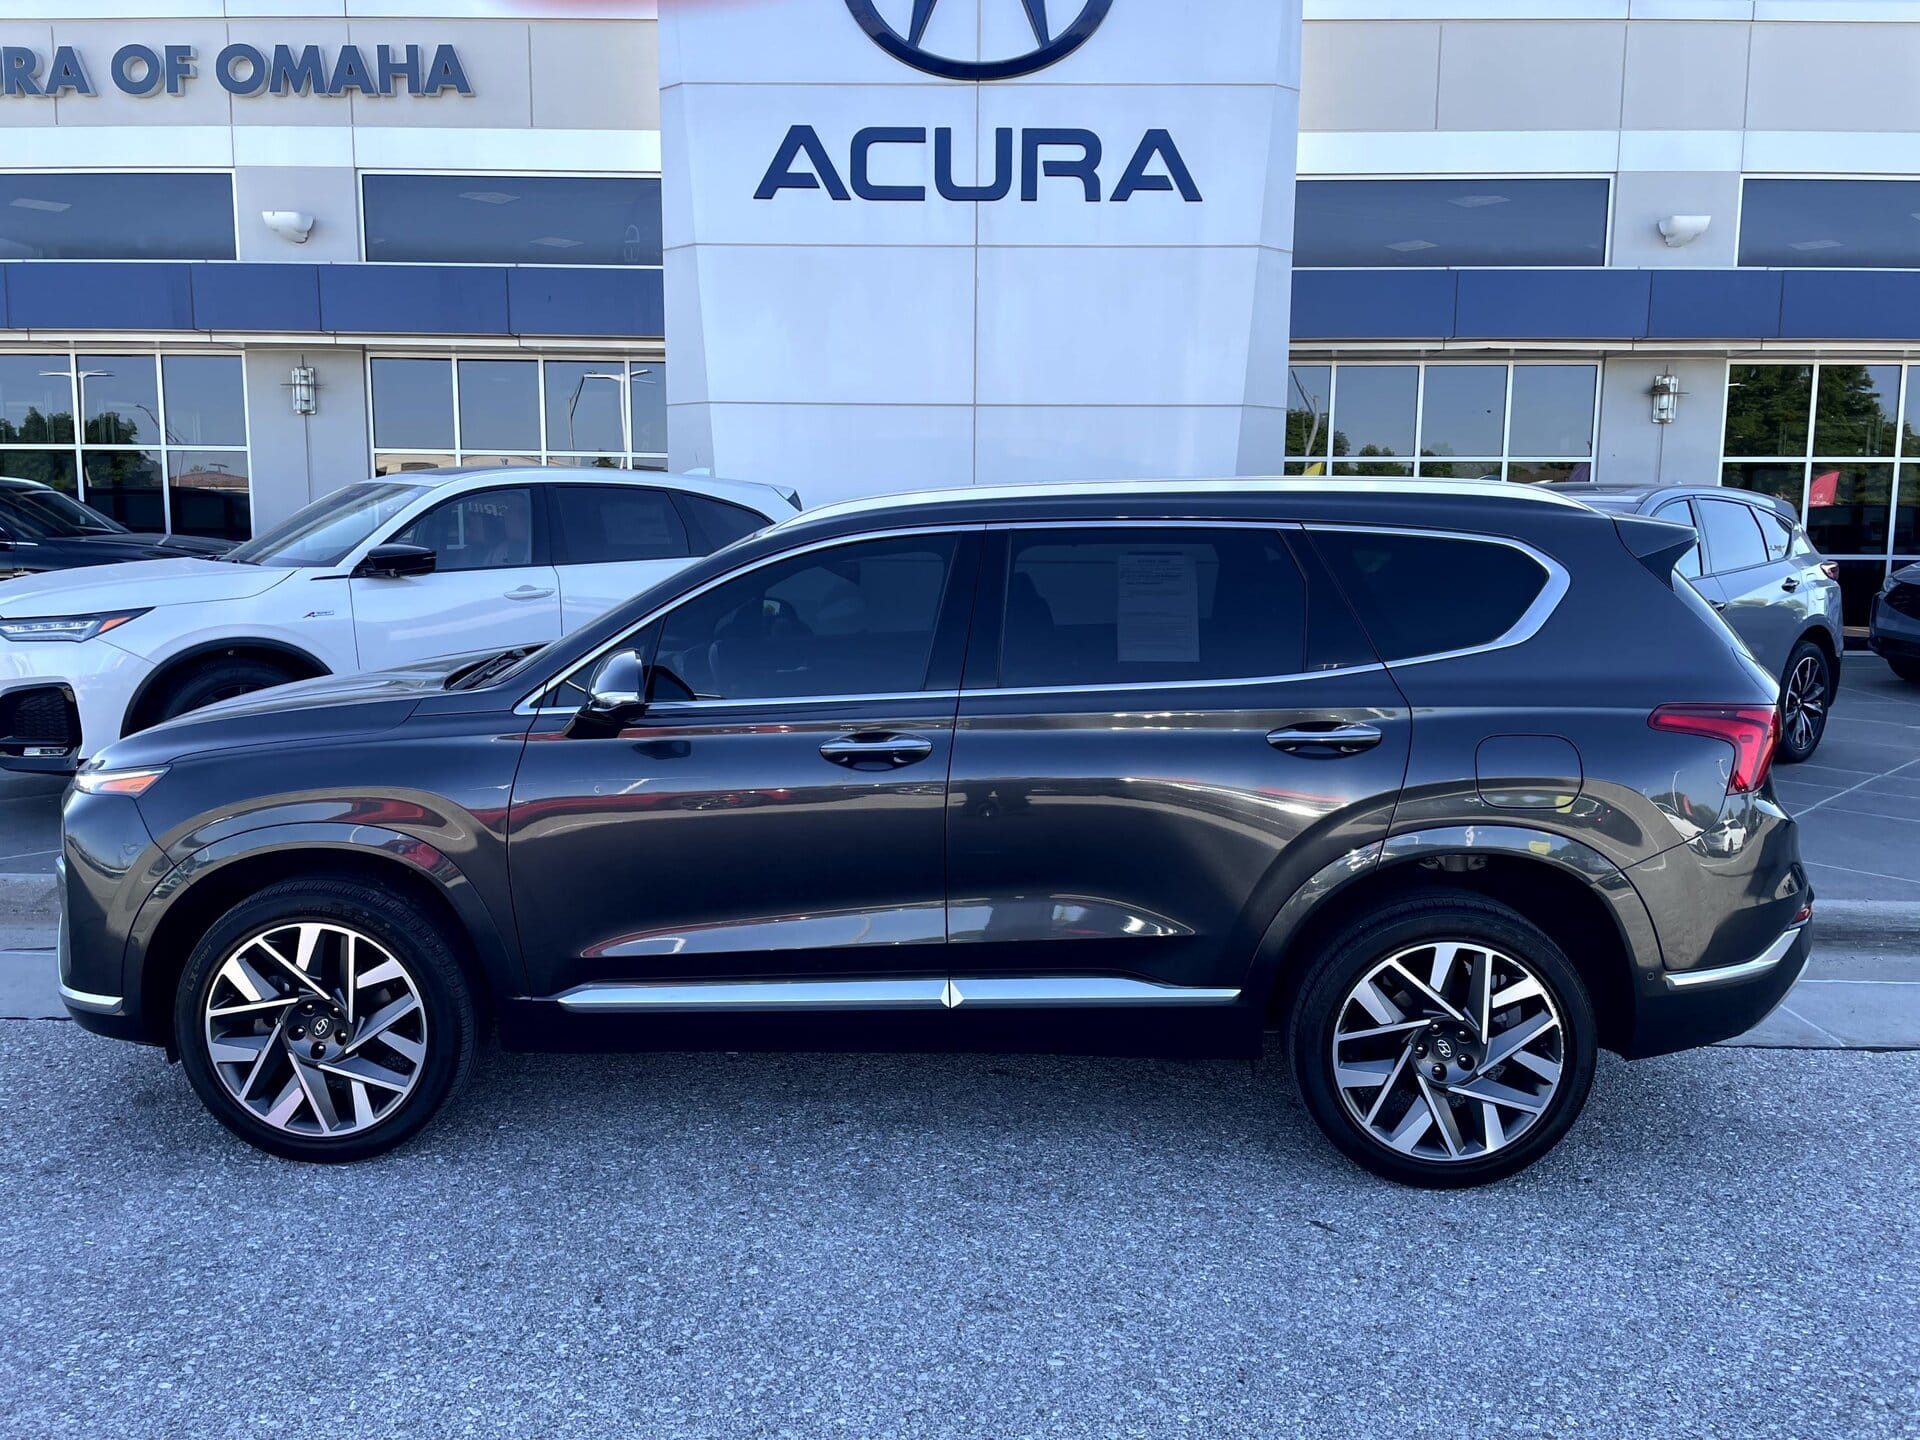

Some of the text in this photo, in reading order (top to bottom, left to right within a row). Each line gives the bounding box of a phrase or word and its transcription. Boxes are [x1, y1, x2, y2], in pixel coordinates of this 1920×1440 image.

[111, 43, 197, 97] OF
[215, 43, 475, 98] OMAHA
[753, 124, 1203, 202] ACURA
